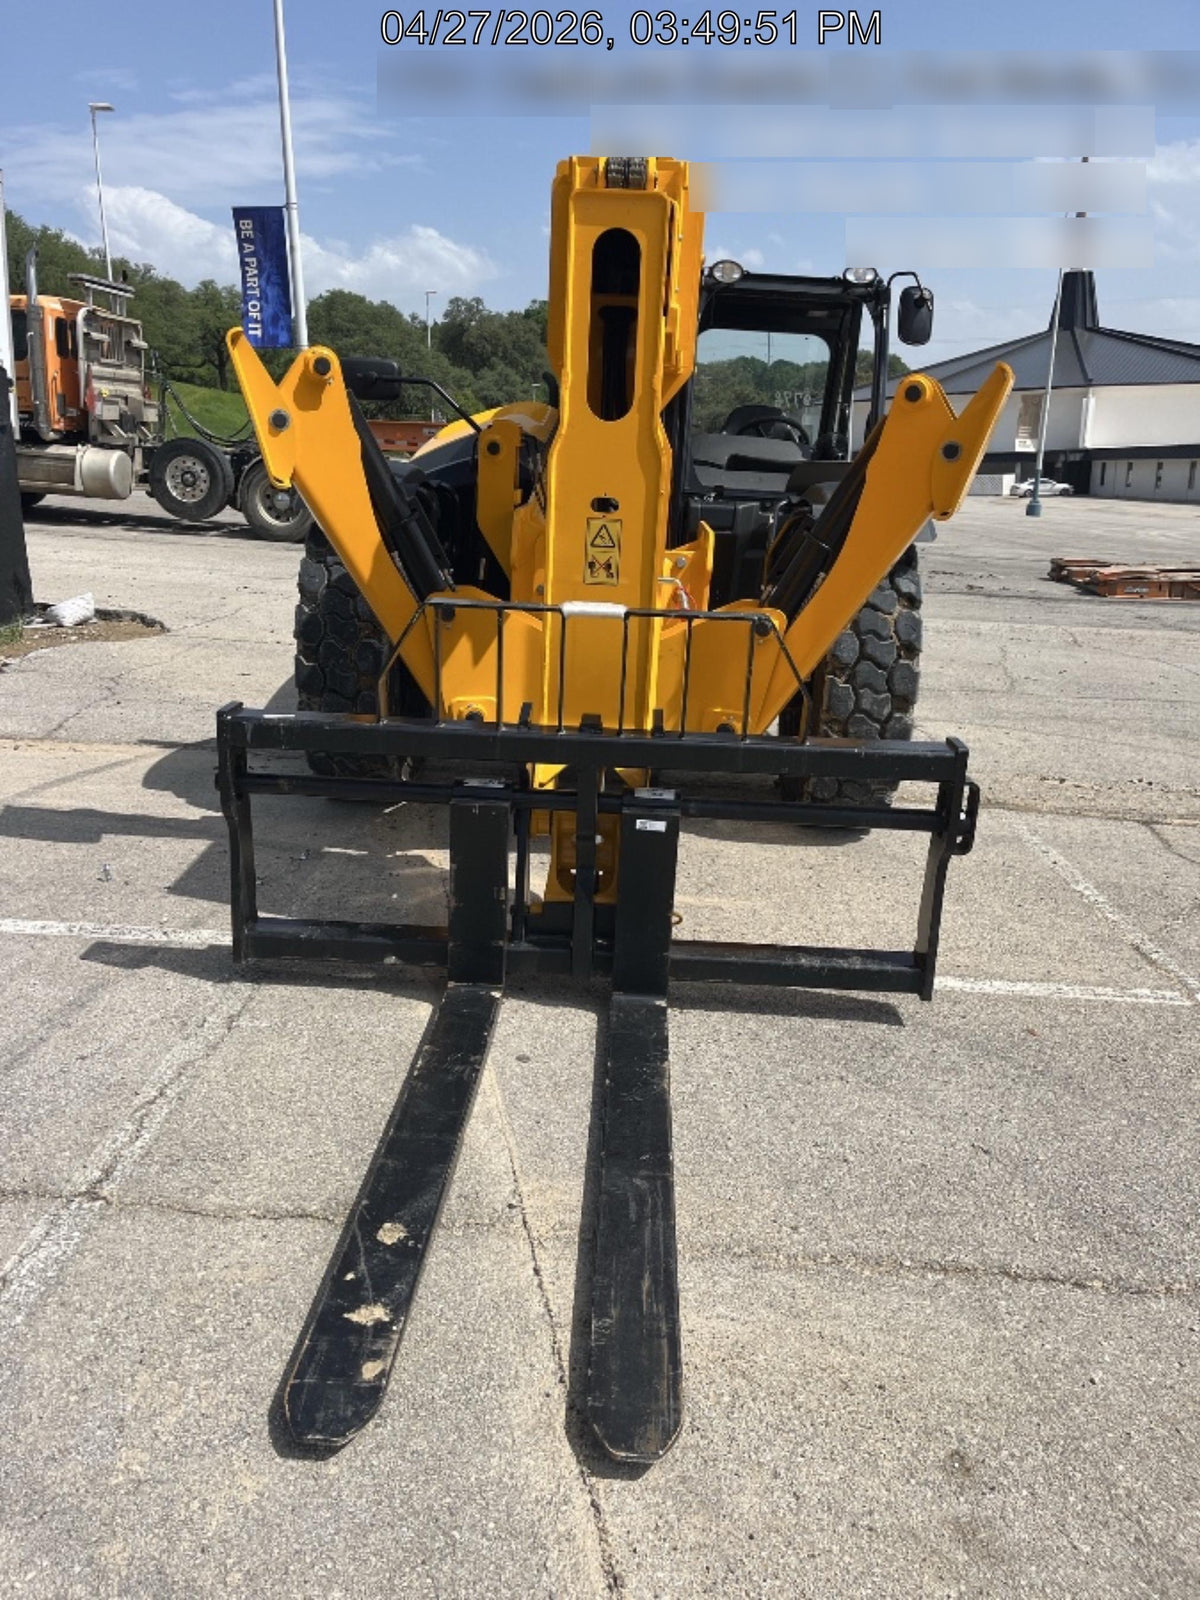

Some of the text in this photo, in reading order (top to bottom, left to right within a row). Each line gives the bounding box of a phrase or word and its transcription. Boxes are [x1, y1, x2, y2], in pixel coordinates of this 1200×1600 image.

[239, 219, 263, 338] BE A PART OF IT
